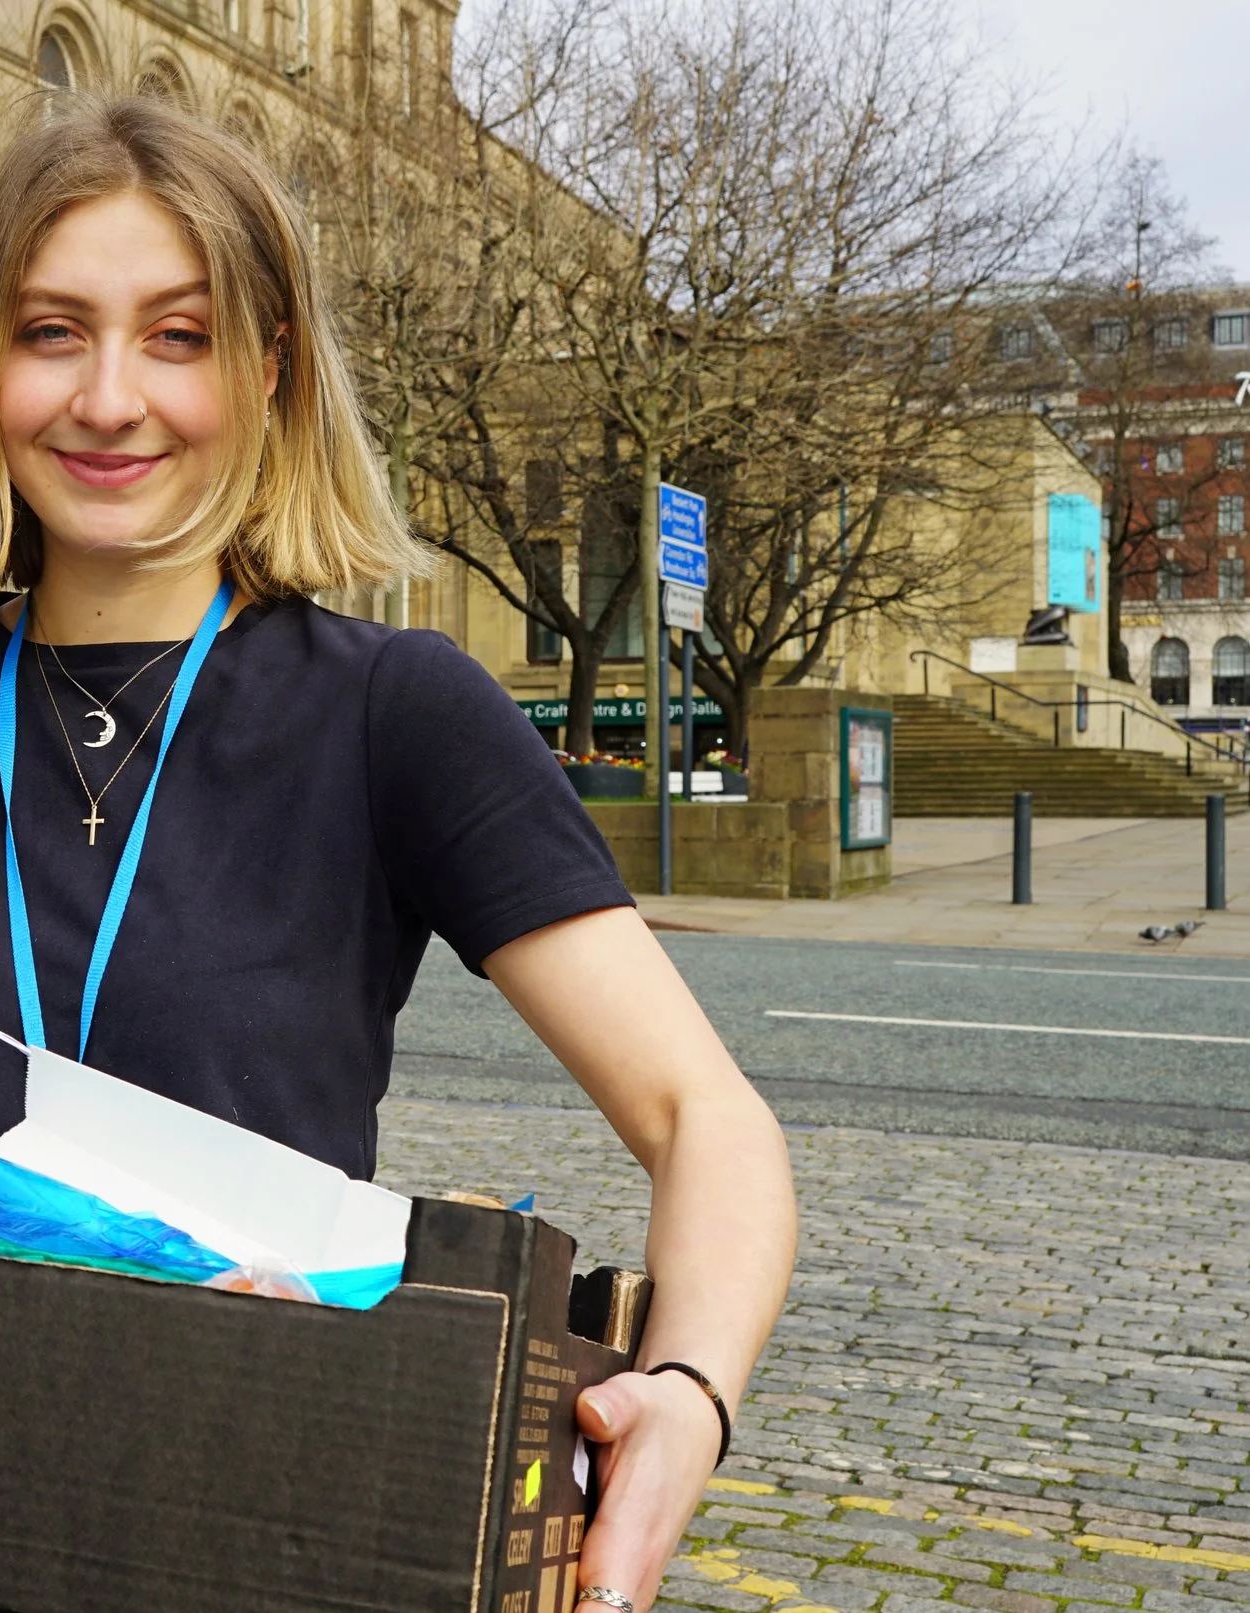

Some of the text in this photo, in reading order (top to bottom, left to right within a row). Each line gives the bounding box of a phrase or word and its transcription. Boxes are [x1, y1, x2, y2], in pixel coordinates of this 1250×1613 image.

[535, 703, 568, 718] Craft
[593, 704, 618, 717] ntre
[621, 702, 632, 716] &
